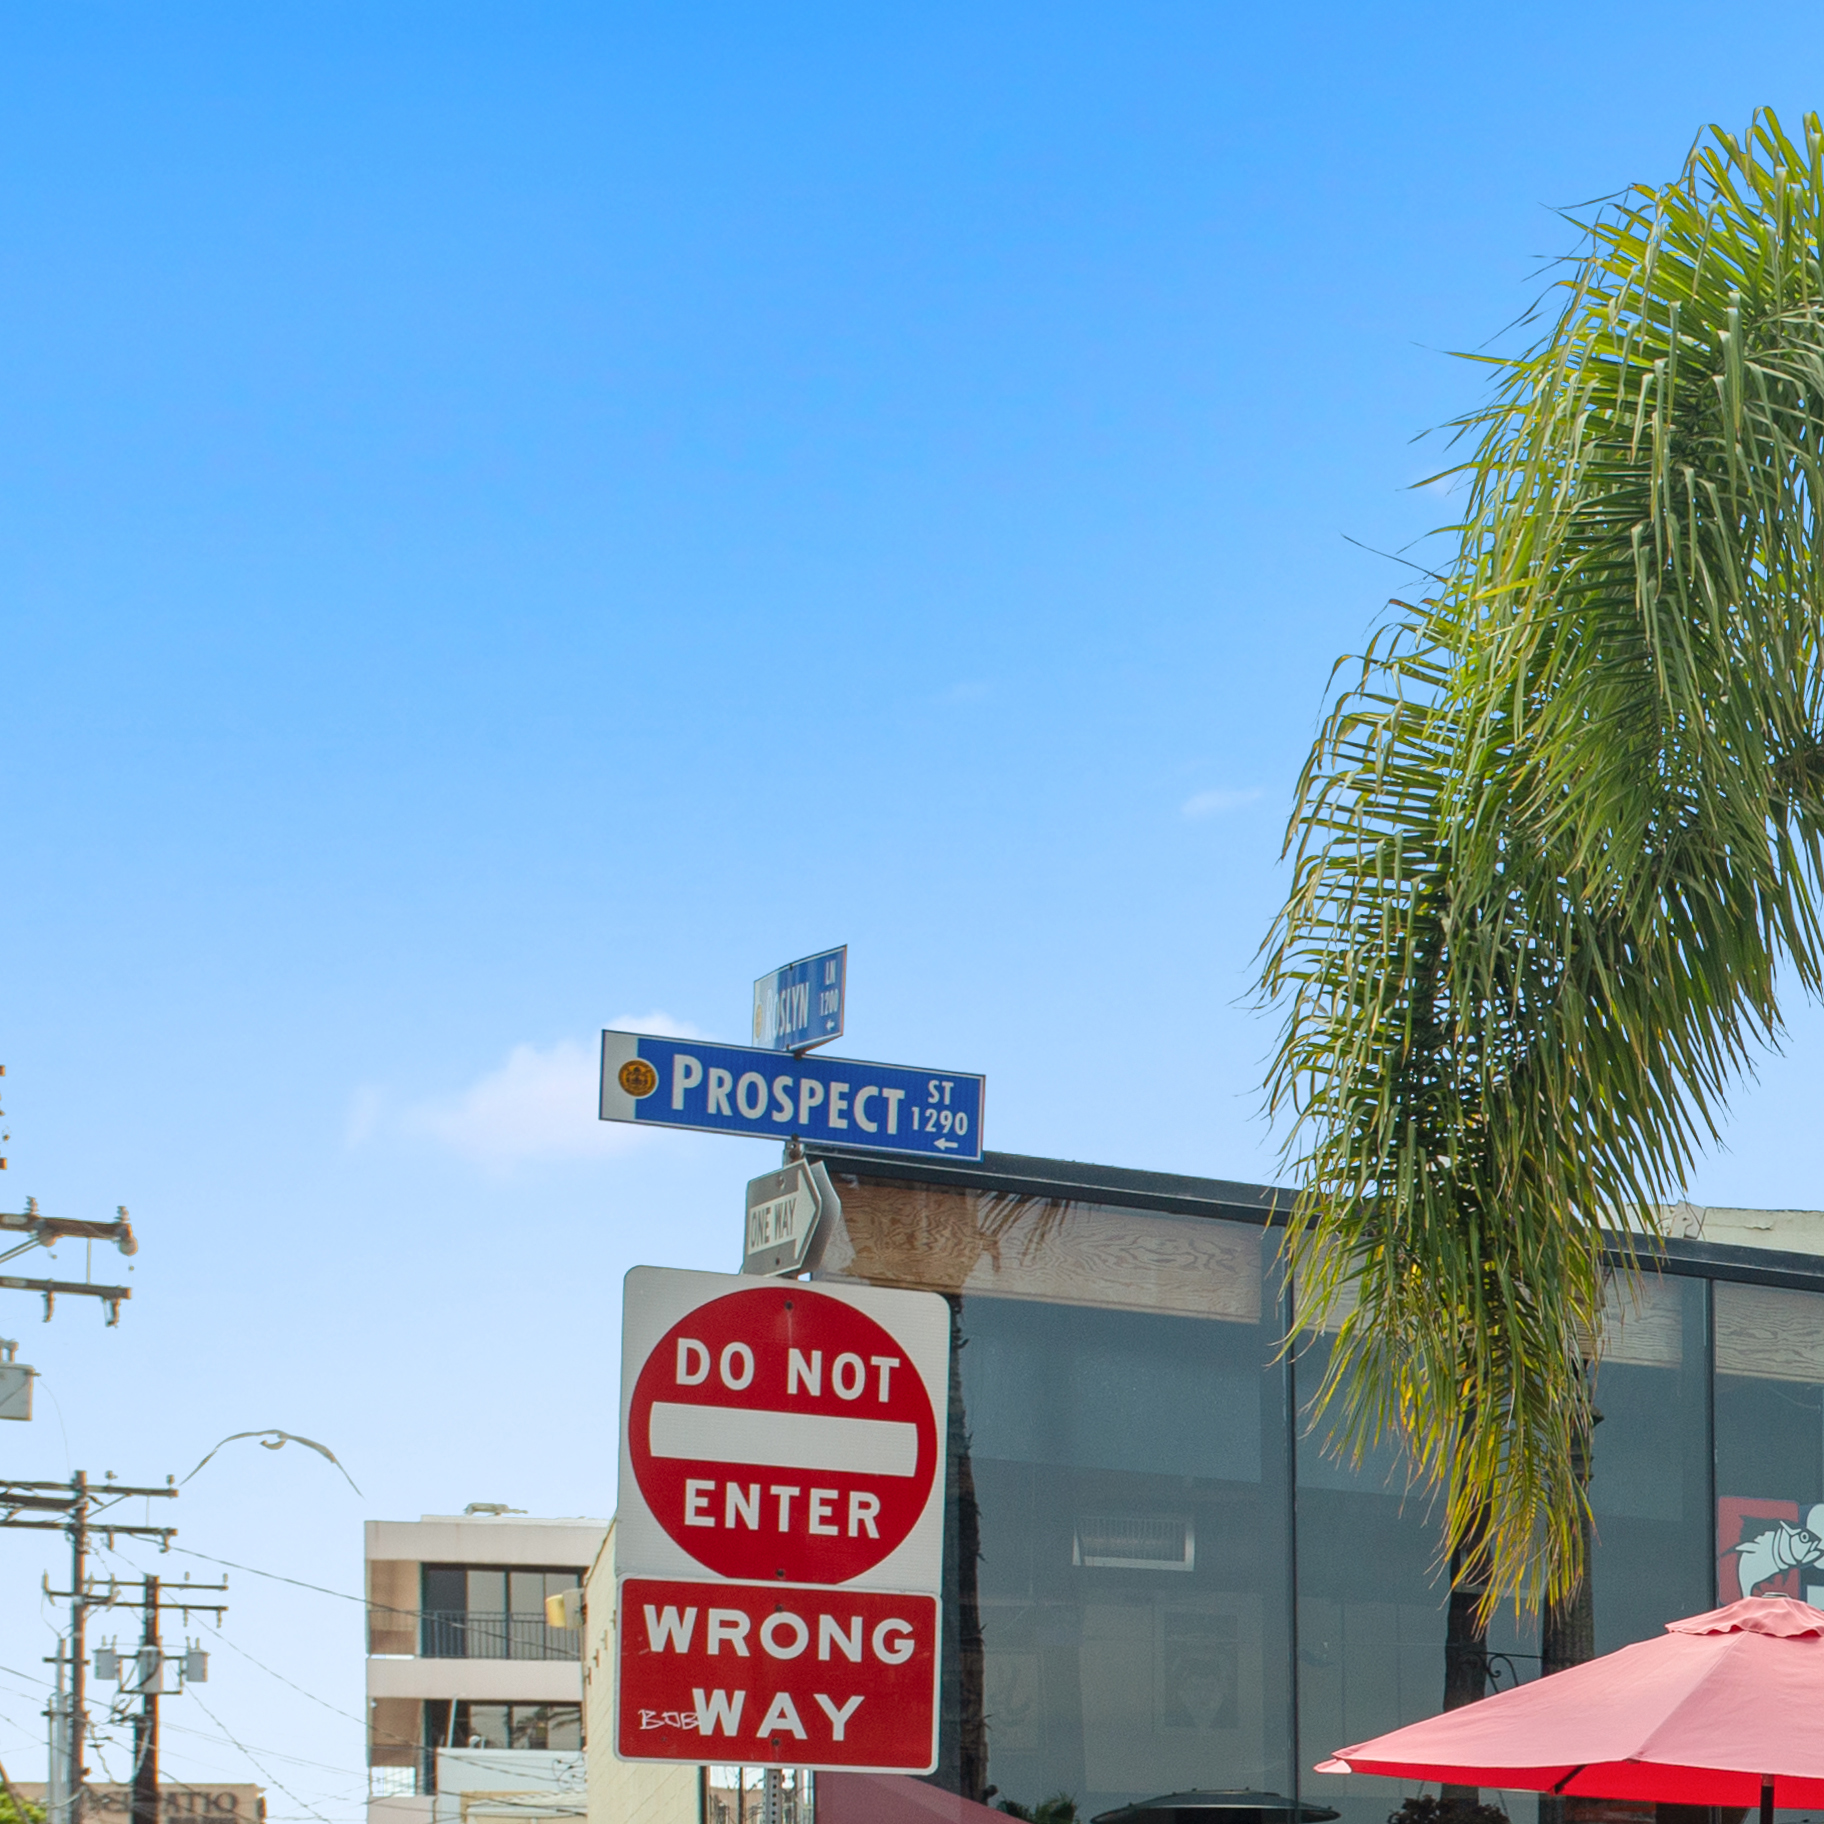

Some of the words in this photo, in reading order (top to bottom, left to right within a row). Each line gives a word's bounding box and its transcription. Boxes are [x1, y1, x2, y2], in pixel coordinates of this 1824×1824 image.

[825, 960, 837, 985] LN
[766, 981, 810, 1037] ROSLYN
[820, 988, 839, 1016] 1200
[671, 1053, 905, 1135] PROSPECT
[926, 1079, 955, 1106] ST
[911, 1106, 969, 1136] 1290
[750, 1206, 771, 1248] ONE
[774, 1197, 797, 1241] WAY
[676, 1338, 755, 1391] DO
[787, 1348, 901, 1403] NOT
[684, 1478, 881, 1539] ENTER
[642, 1604, 916, 1665] WRONG
[692, 1688, 865, 1742] WAY
